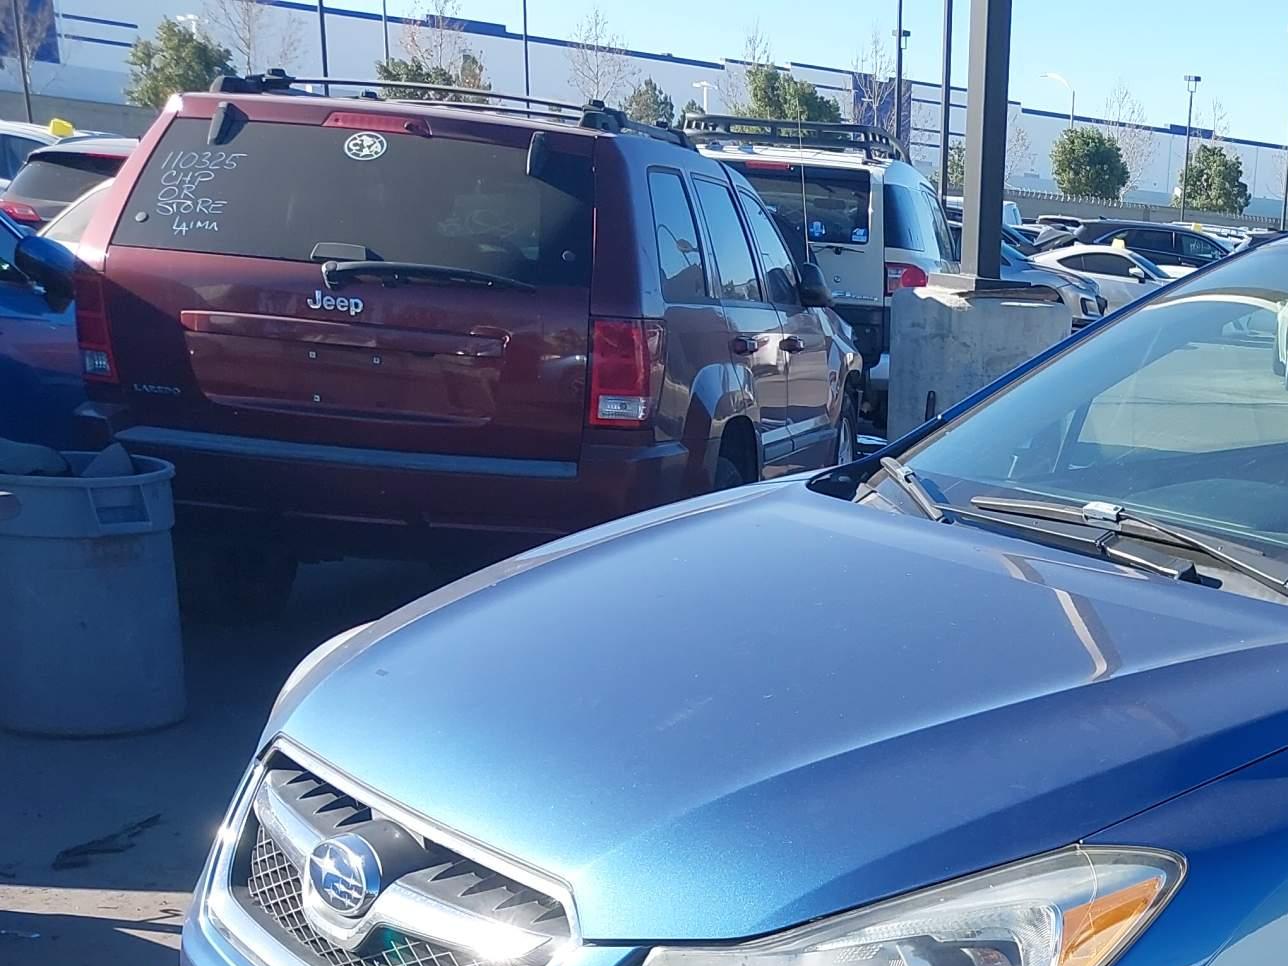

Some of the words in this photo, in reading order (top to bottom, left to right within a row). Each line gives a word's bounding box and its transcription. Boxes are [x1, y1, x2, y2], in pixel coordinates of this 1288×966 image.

[160, 151, 249, 170] 110325
[160, 169, 215, 186] CHP
[158, 184, 196, 201] OR
[156, 198, 228, 216] STORE
[306, 289, 364, 316] Jeep
